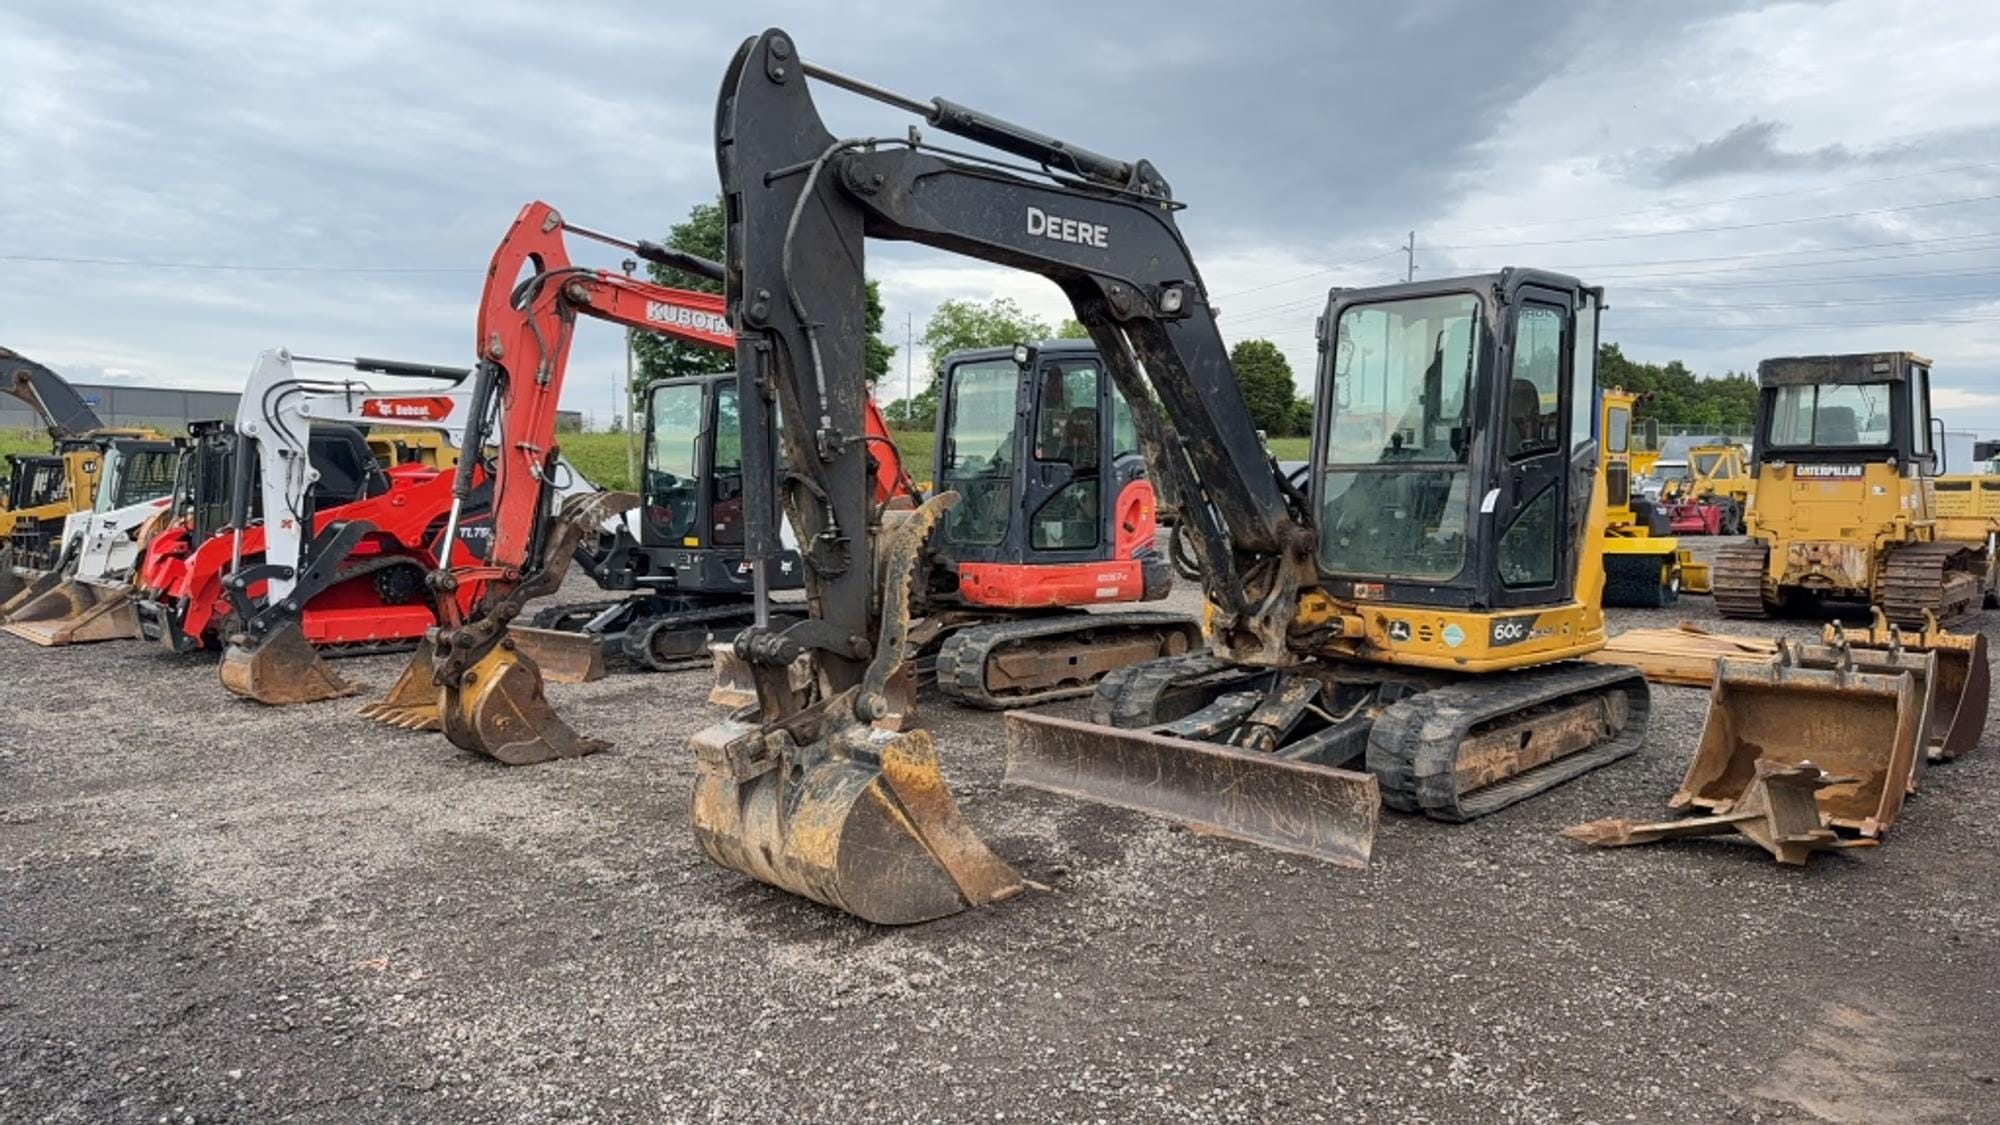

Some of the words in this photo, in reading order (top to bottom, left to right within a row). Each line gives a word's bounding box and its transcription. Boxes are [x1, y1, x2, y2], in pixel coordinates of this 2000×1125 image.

[1027, 206, 1109, 248] DEERE
[646, 300, 733, 336] KUBOTA
[396, 404, 430, 416] Bobcat
[1796, 465, 1862, 477] CATERPILLAR
